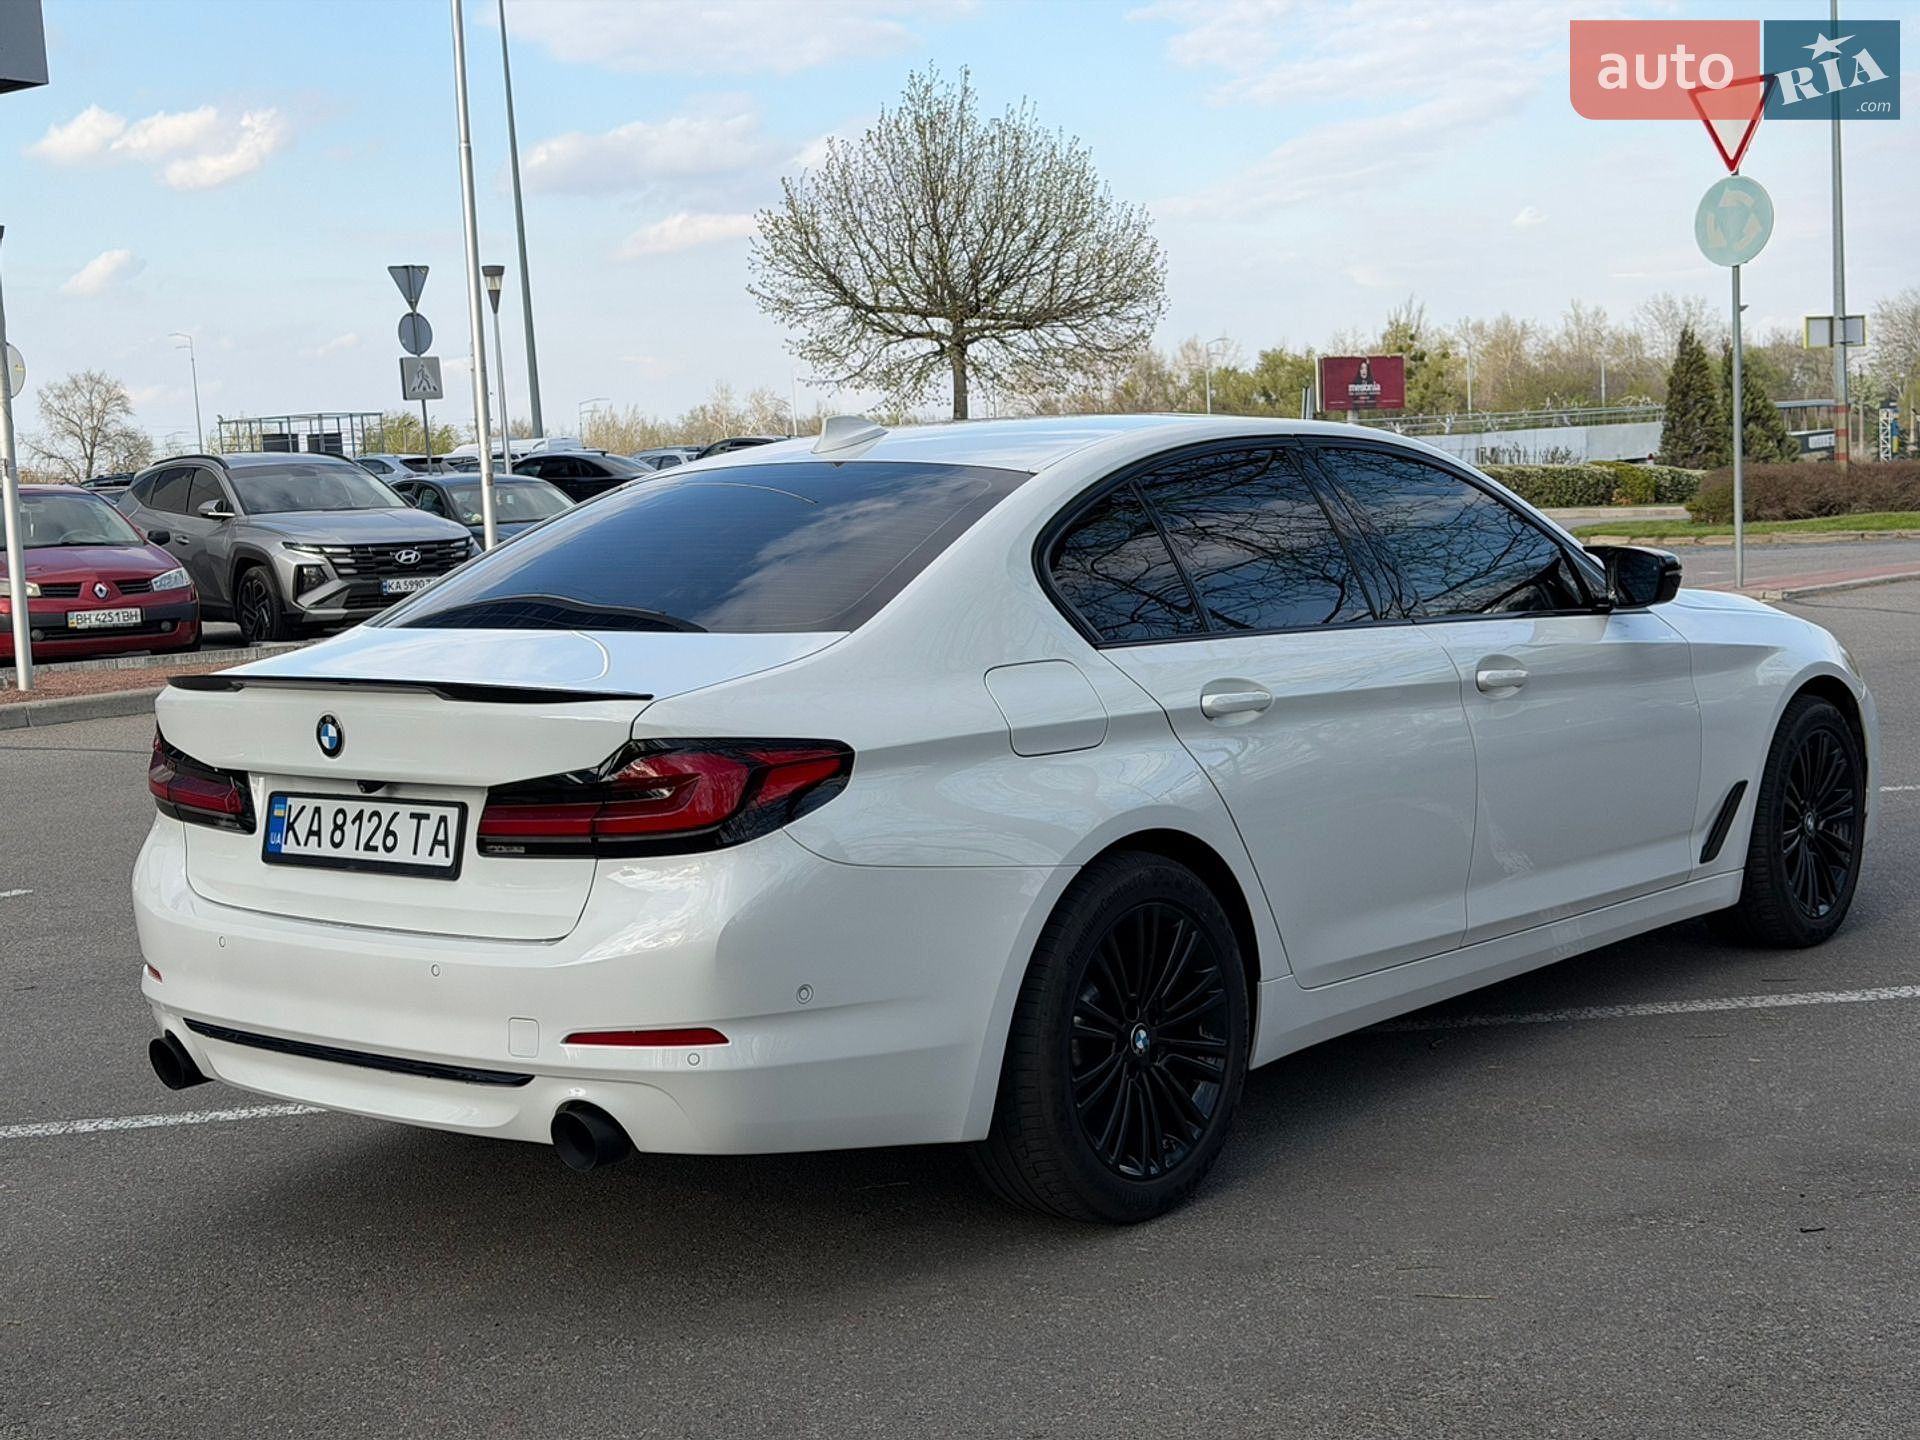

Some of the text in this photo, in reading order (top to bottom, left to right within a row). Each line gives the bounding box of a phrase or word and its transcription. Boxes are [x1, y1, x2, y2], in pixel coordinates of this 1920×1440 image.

[388, 581, 401, 591] KA
[403, 579, 425, 591] 5990
[284, 804, 450, 858] KA 8126 TA
[270, 833, 281, 845] UA
